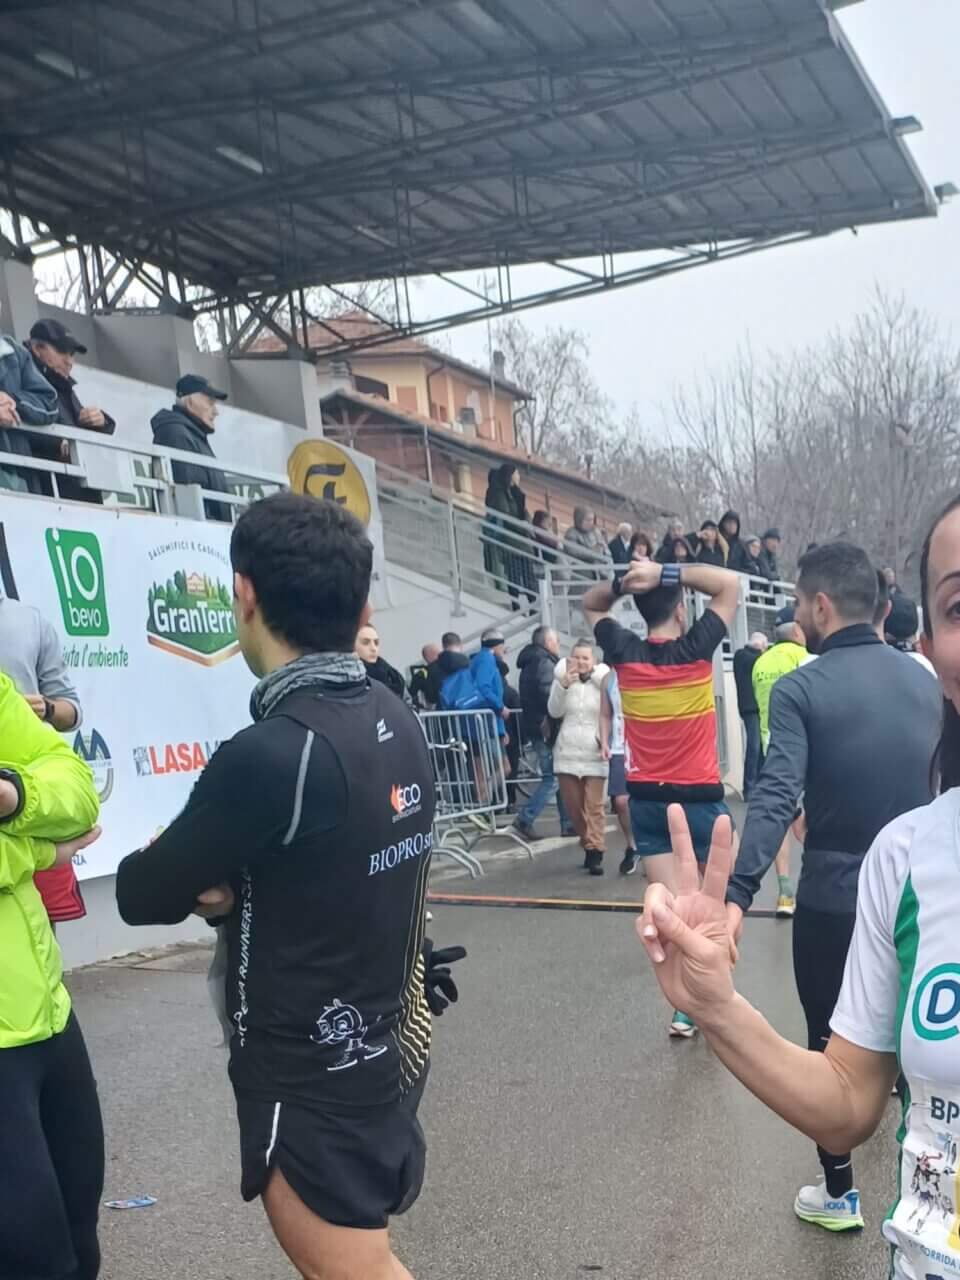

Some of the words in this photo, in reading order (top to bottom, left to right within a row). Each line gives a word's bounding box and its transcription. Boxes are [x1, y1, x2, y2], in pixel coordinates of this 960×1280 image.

[68, 601, 102, 628] bevo
[153, 597, 237, 634] GranTerr
[368, 832, 423, 877] BIOPRO
[239, 899, 253, 979] RUNNERS
